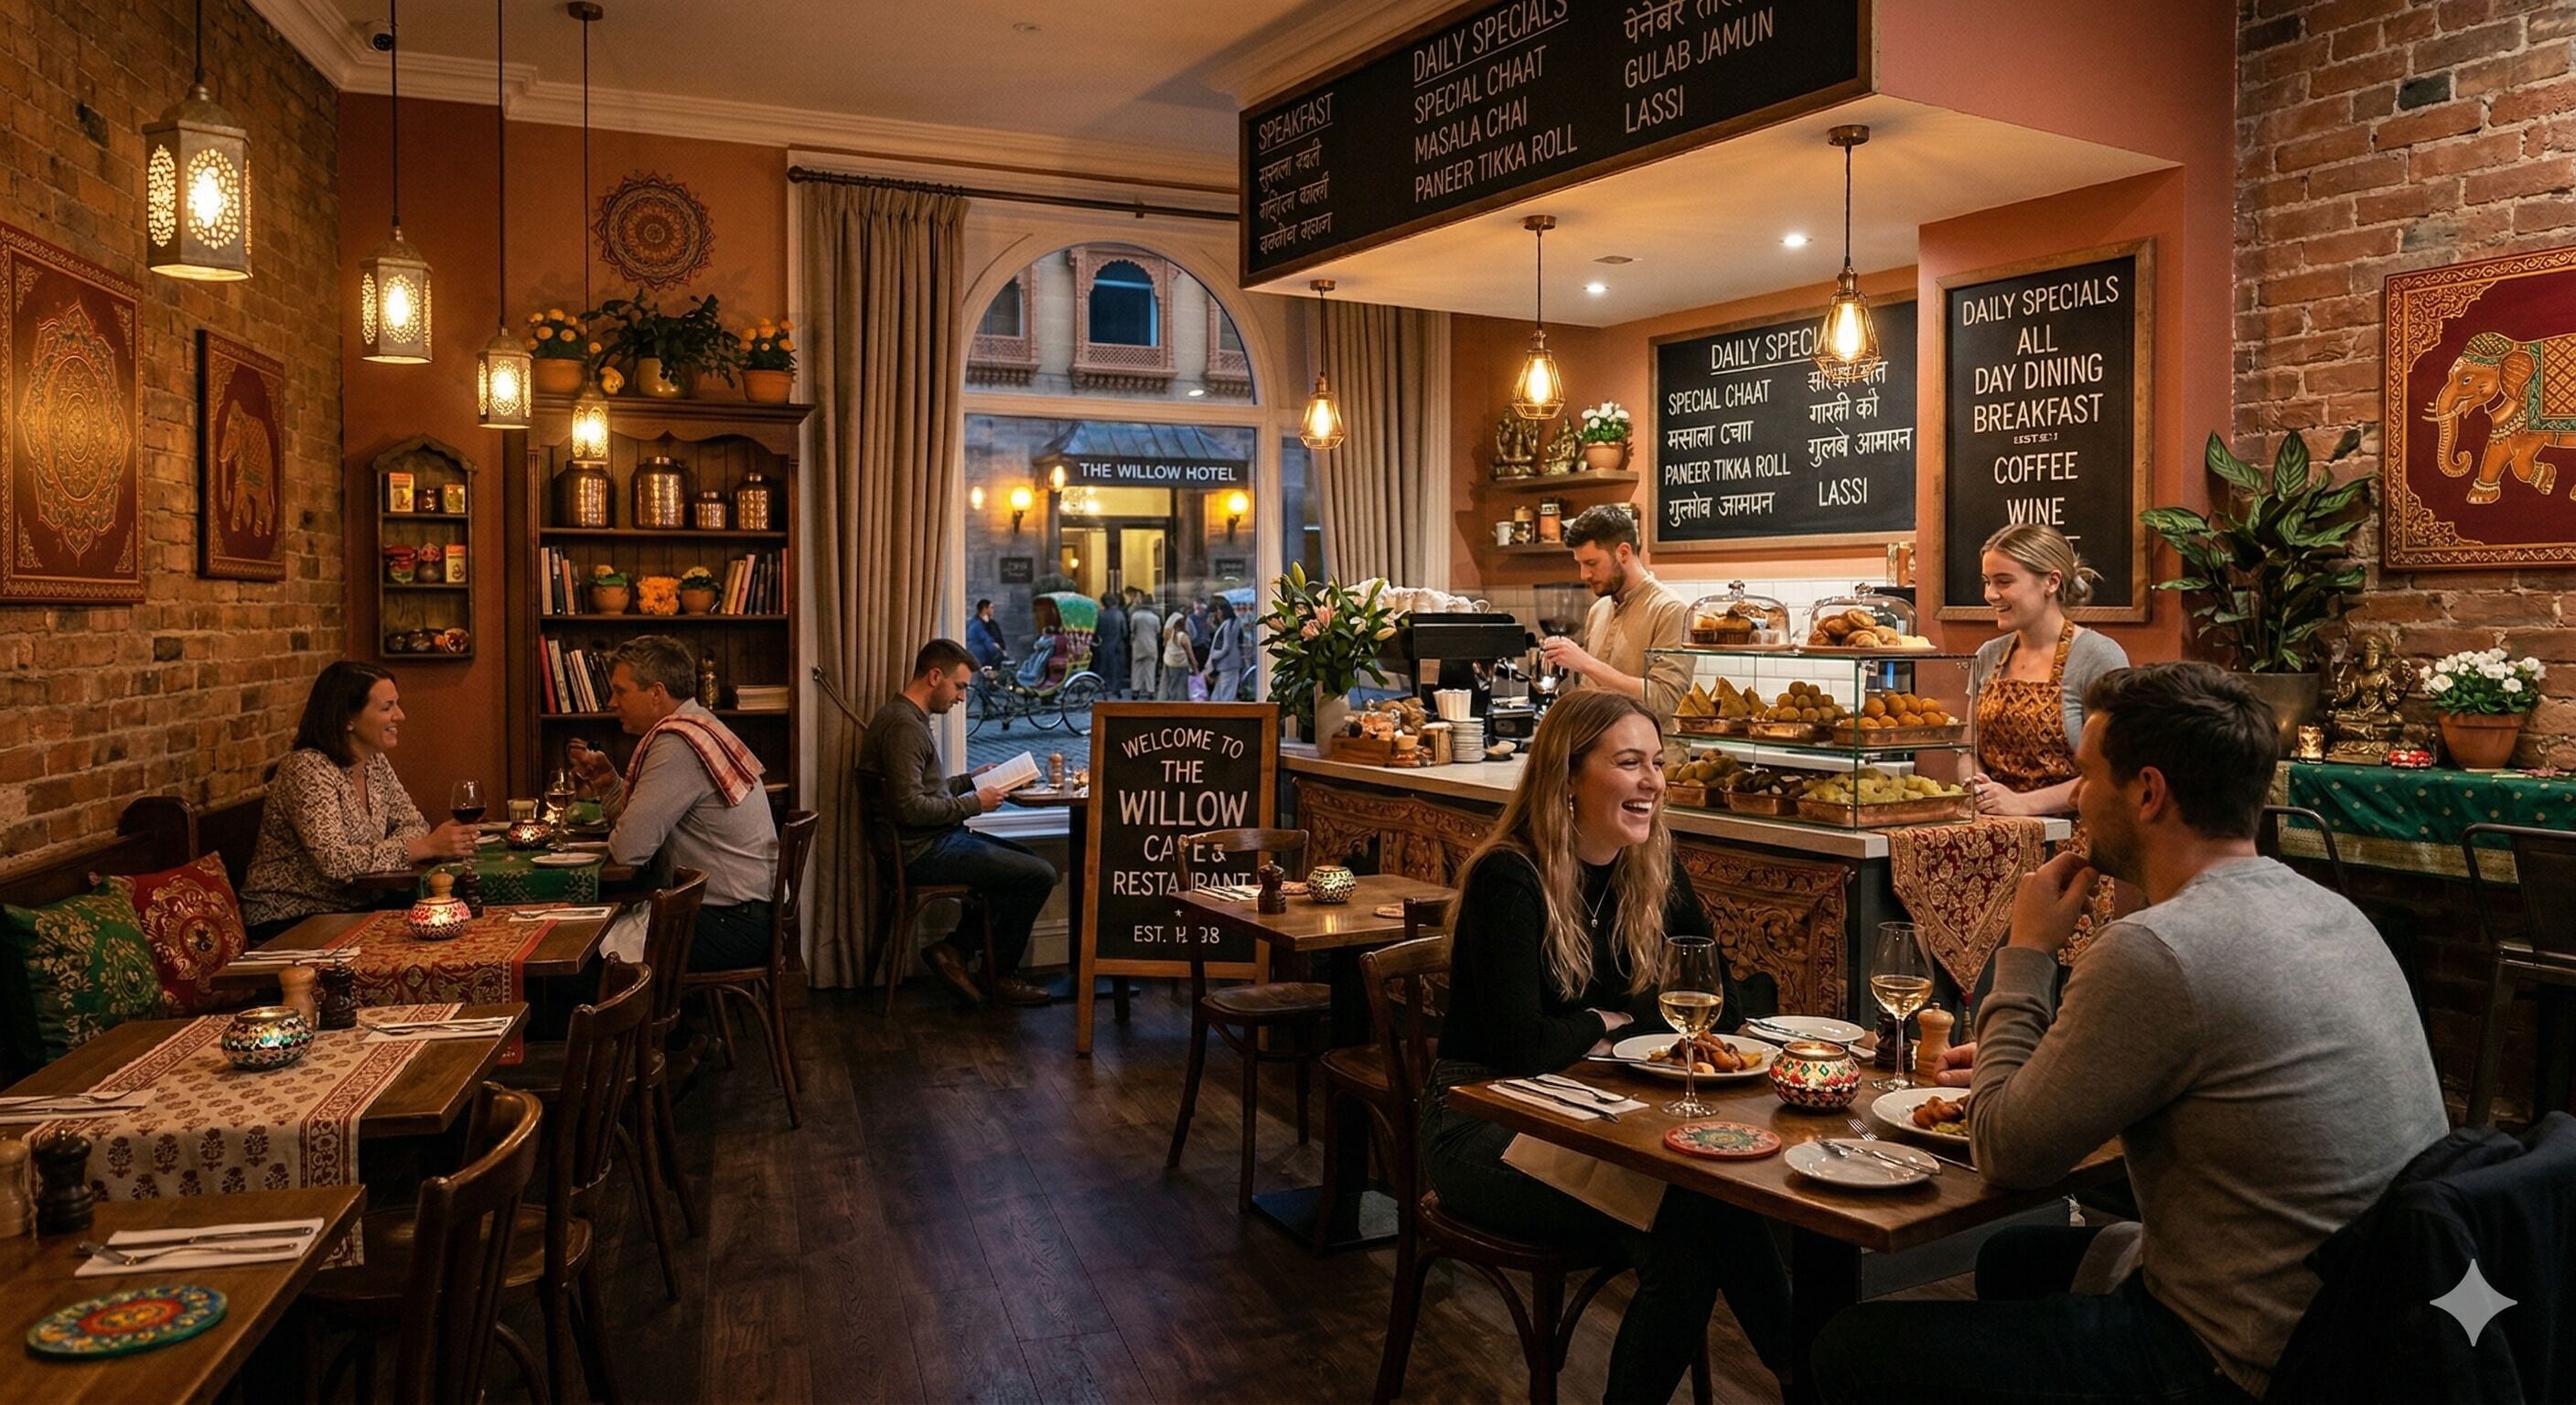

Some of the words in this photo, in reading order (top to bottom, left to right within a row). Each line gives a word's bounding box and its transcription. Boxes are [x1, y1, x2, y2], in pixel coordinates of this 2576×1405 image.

[1414, 28, 1465, 81] DAILY
[1625, 39, 1690, 88] GULAB
[1697, 6, 1773, 64] JAMUN
[1414, 74, 1482, 123] SPECIAL
[1487, 45, 1546, 95] CHAAT
[1259, 92, 1334, 150] SPEAKFAST
[1626, 84, 1683, 134] LASSI
[1415, 114, 1481, 164] MASALA
[1487, 95, 1527, 137] CHAI
[1415, 159, 1474, 203] PANEER
[1478, 141, 1527, 181] TIKKA
[1532, 123, 1578, 164] ROLL
[1962, 293, 2015, 327] DAILY
[2023, 275, 2120, 316] SPECIALS
[1712, 337, 1760, 370] DAILY
[1766, 326, 1821, 361] SPECI
[2016, 324, 2058, 356] ALL
[1974, 364, 2016, 396] DAY
[2024, 352, 2103, 390] DINING
[1668, 389, 1722, 415] SPECIAL
[1725, 380, 1771, 407] CHAAT
[1974, 393, 2104, 434] BREAKFAST
[1668, 425, 1716, 450] मसाला
[1079, 463, 1111, 477] THE
[1117, 464, 1181, 479] WILLOW
[1186, 467, 1237, 481] HOTEL
[1665, 461, 1710, 486] PANEER
[1713, 456, 1752, 481] TIKKA
[1756, 453, 1791, 477] ROLL
[1994, 451, 2078, 484] COFFEE
[1819, 477, 1868, 507] LASSI
[2007, 497, 2065, 526] WINE
[1122, 727, 1215, 759] WELCOME
[1220, 735, 1244, 758] TO
[1161, 760, 1204, 783] THE
[1119, 789, 1248, 827] WILLOW
[1144, 834, 1206, 863] CAE
[1113, 871, 1250, 896] RESTARANT
[1133, 926, 1166, 943] EST.
